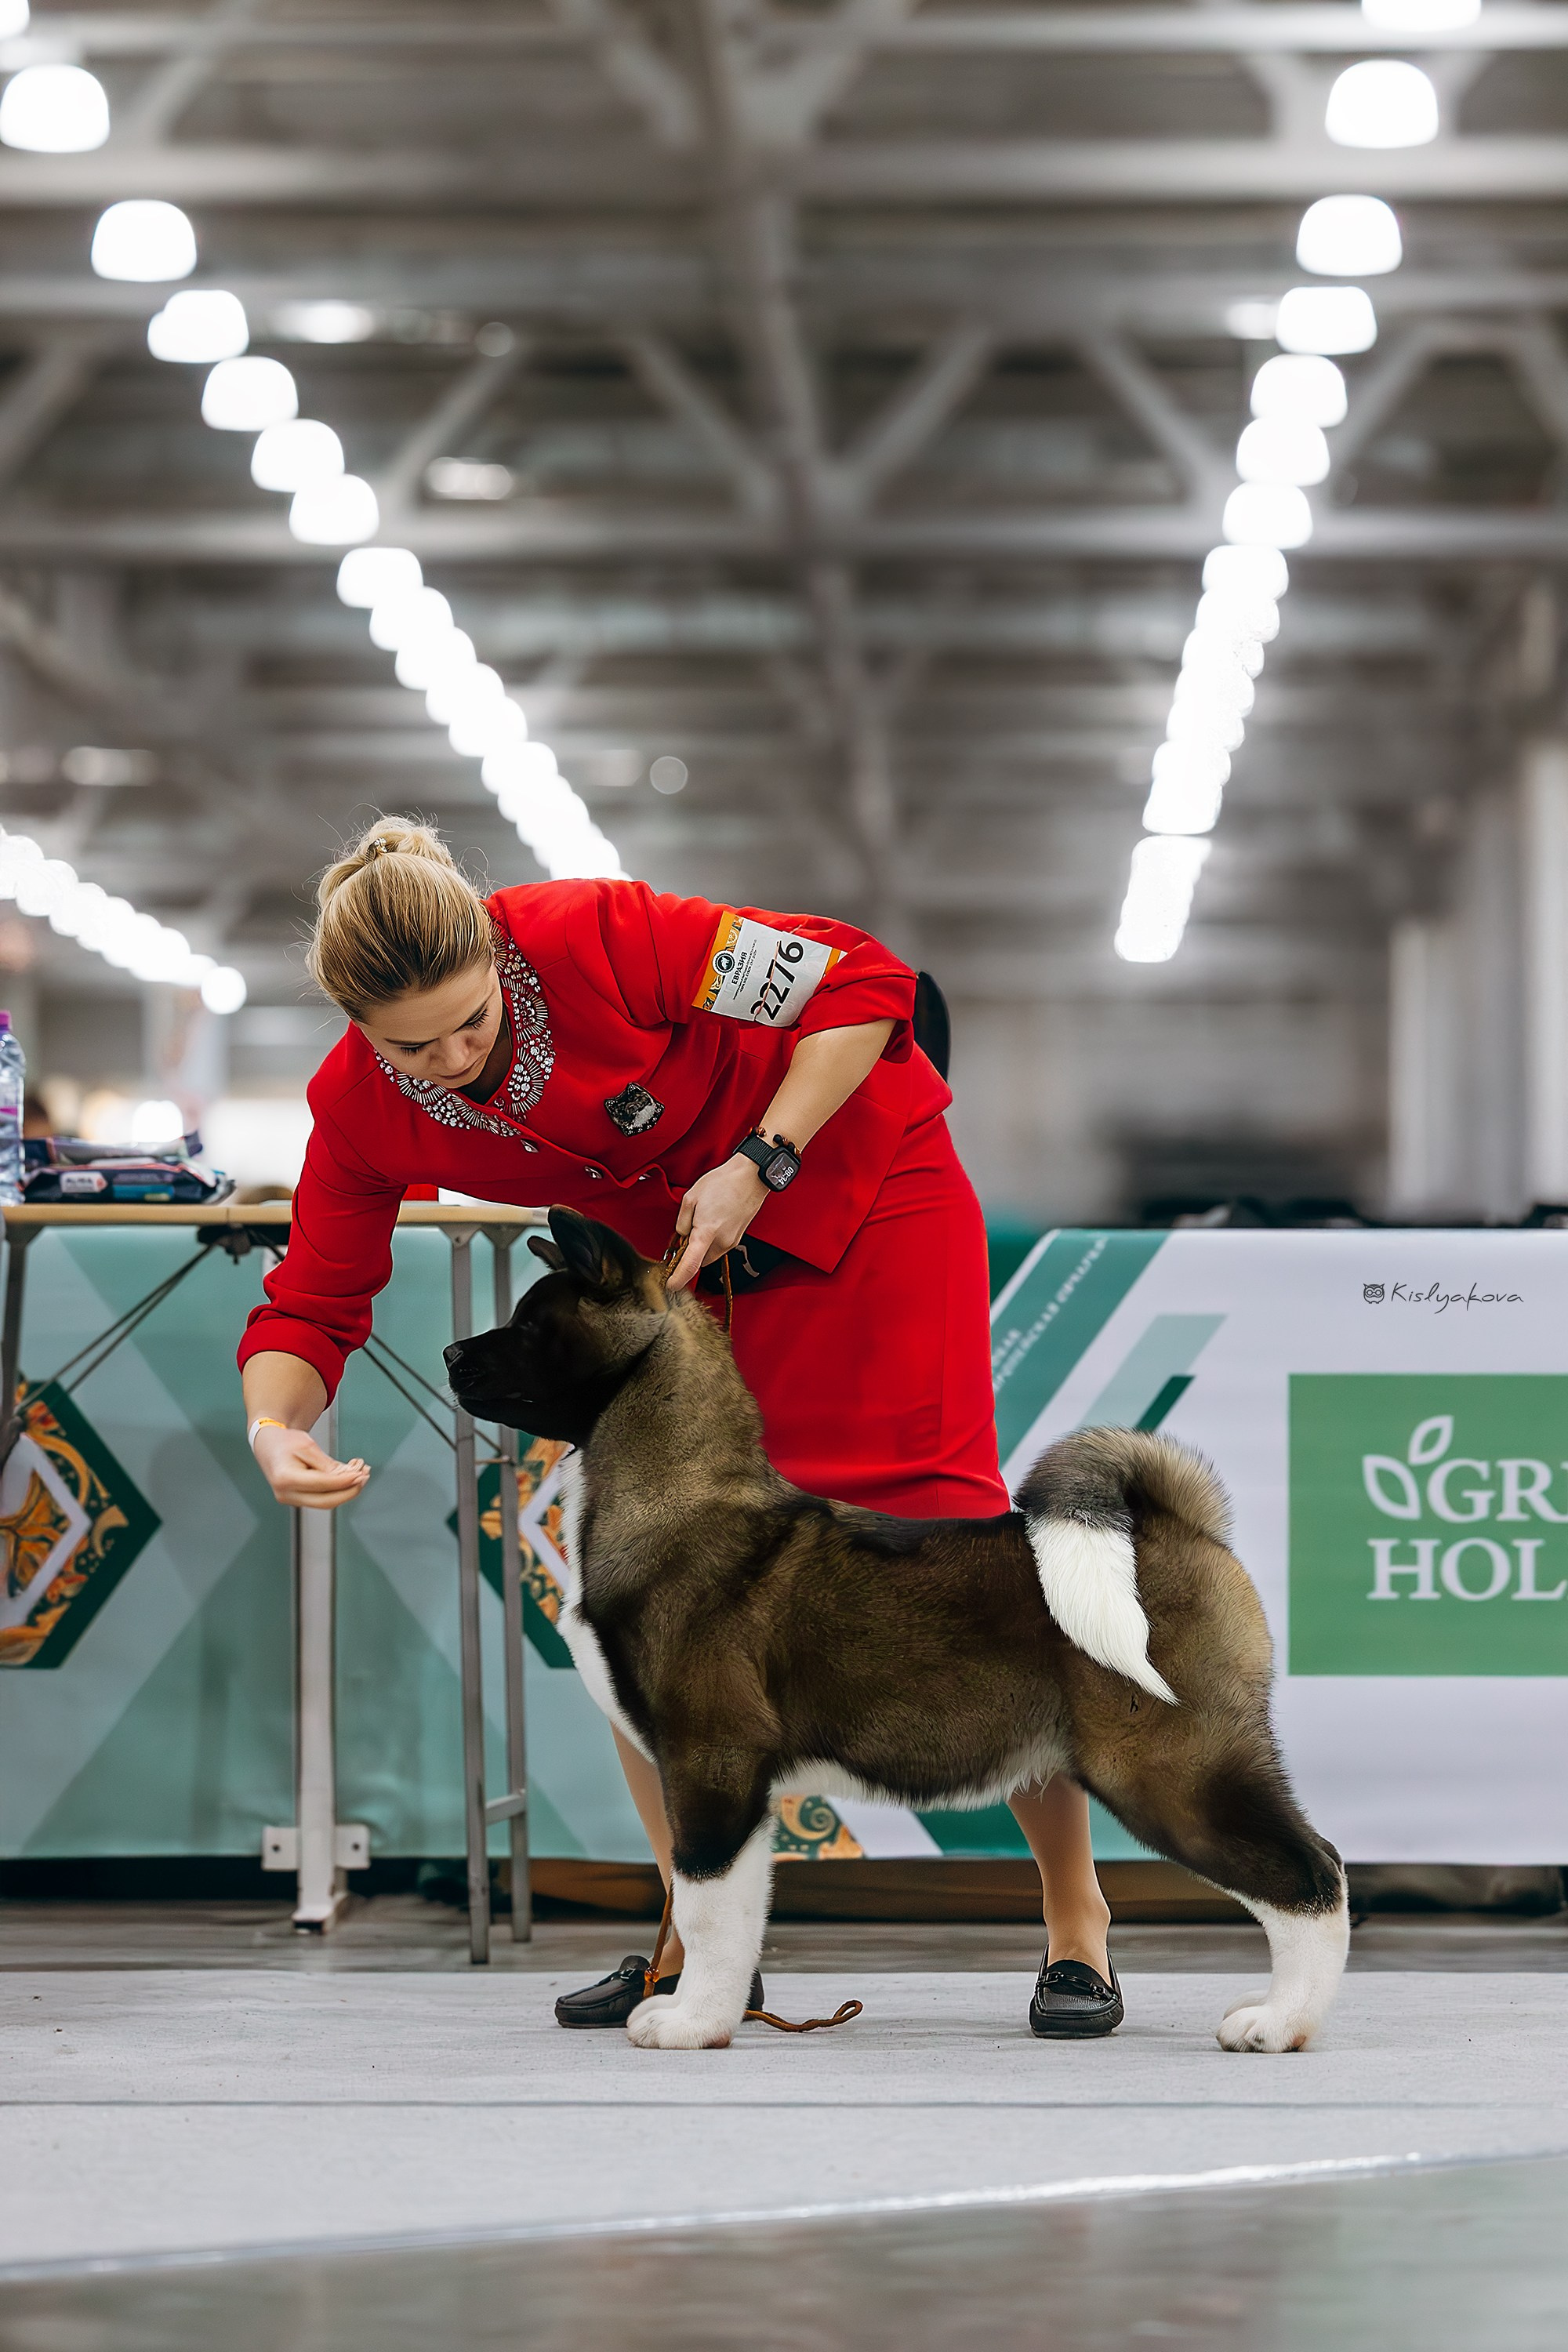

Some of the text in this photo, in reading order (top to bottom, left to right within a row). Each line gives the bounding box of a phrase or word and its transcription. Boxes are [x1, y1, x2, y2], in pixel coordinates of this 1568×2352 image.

[731, 951, 748, 985] ЕВРАЗИЯ
[750, 941, 804, 1021] 2276
[1427, 1457, 1568, 1523] GR
[1367, 1537, 1568, 1602] HOL
